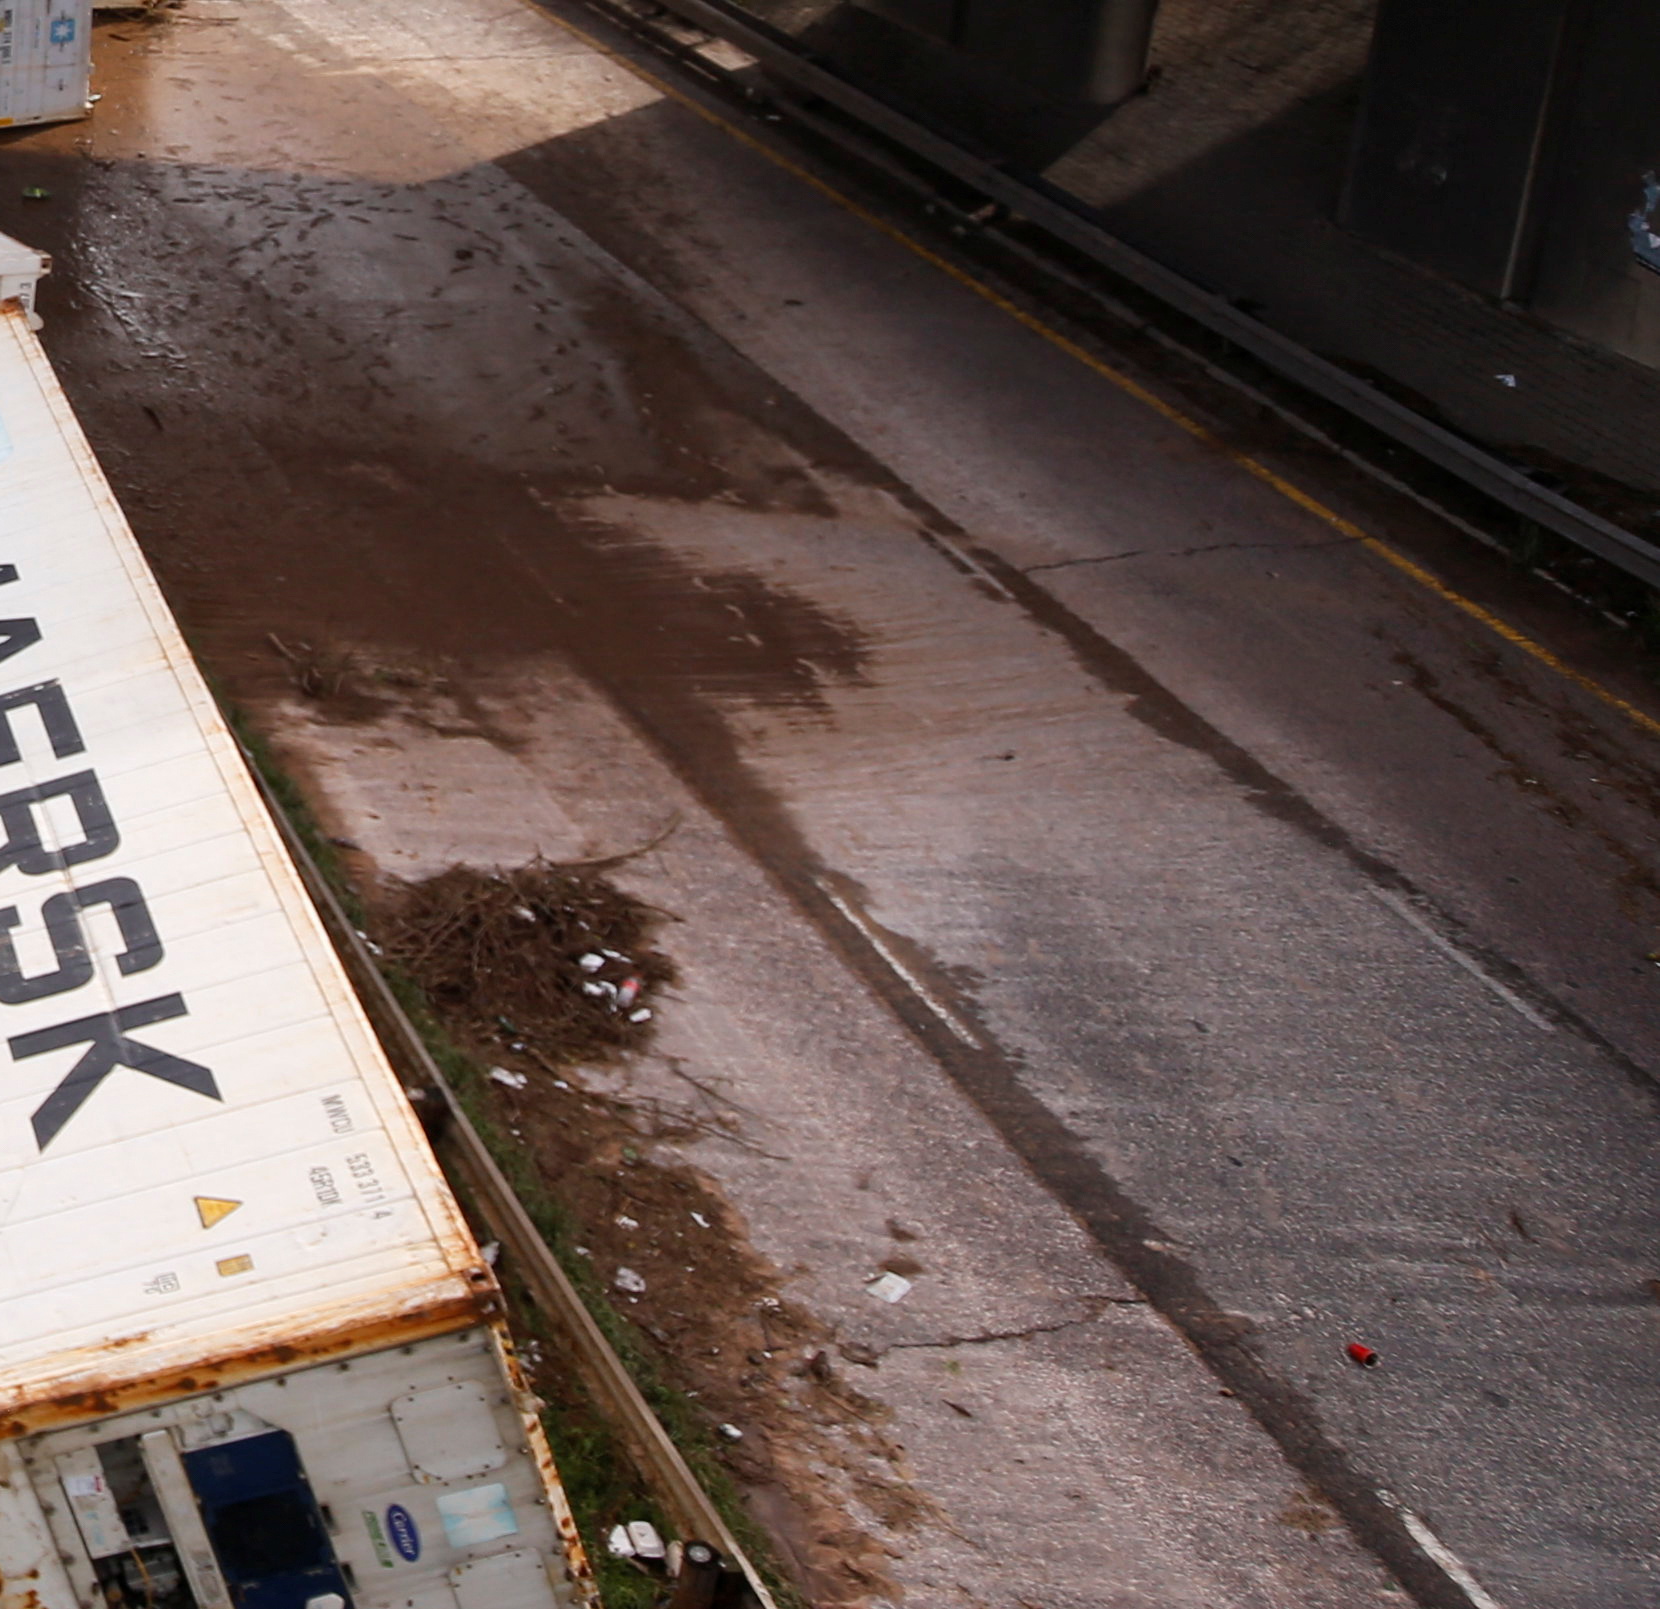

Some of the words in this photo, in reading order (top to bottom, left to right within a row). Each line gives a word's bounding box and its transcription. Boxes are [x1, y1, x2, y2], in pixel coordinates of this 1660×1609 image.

[321, 1093, 355, 1134] MWCU
[345, 1152, 375, 1180] 533
[358, 1182, 385, 1203] 371
[390, 1510, 417, 1557] Carrier
